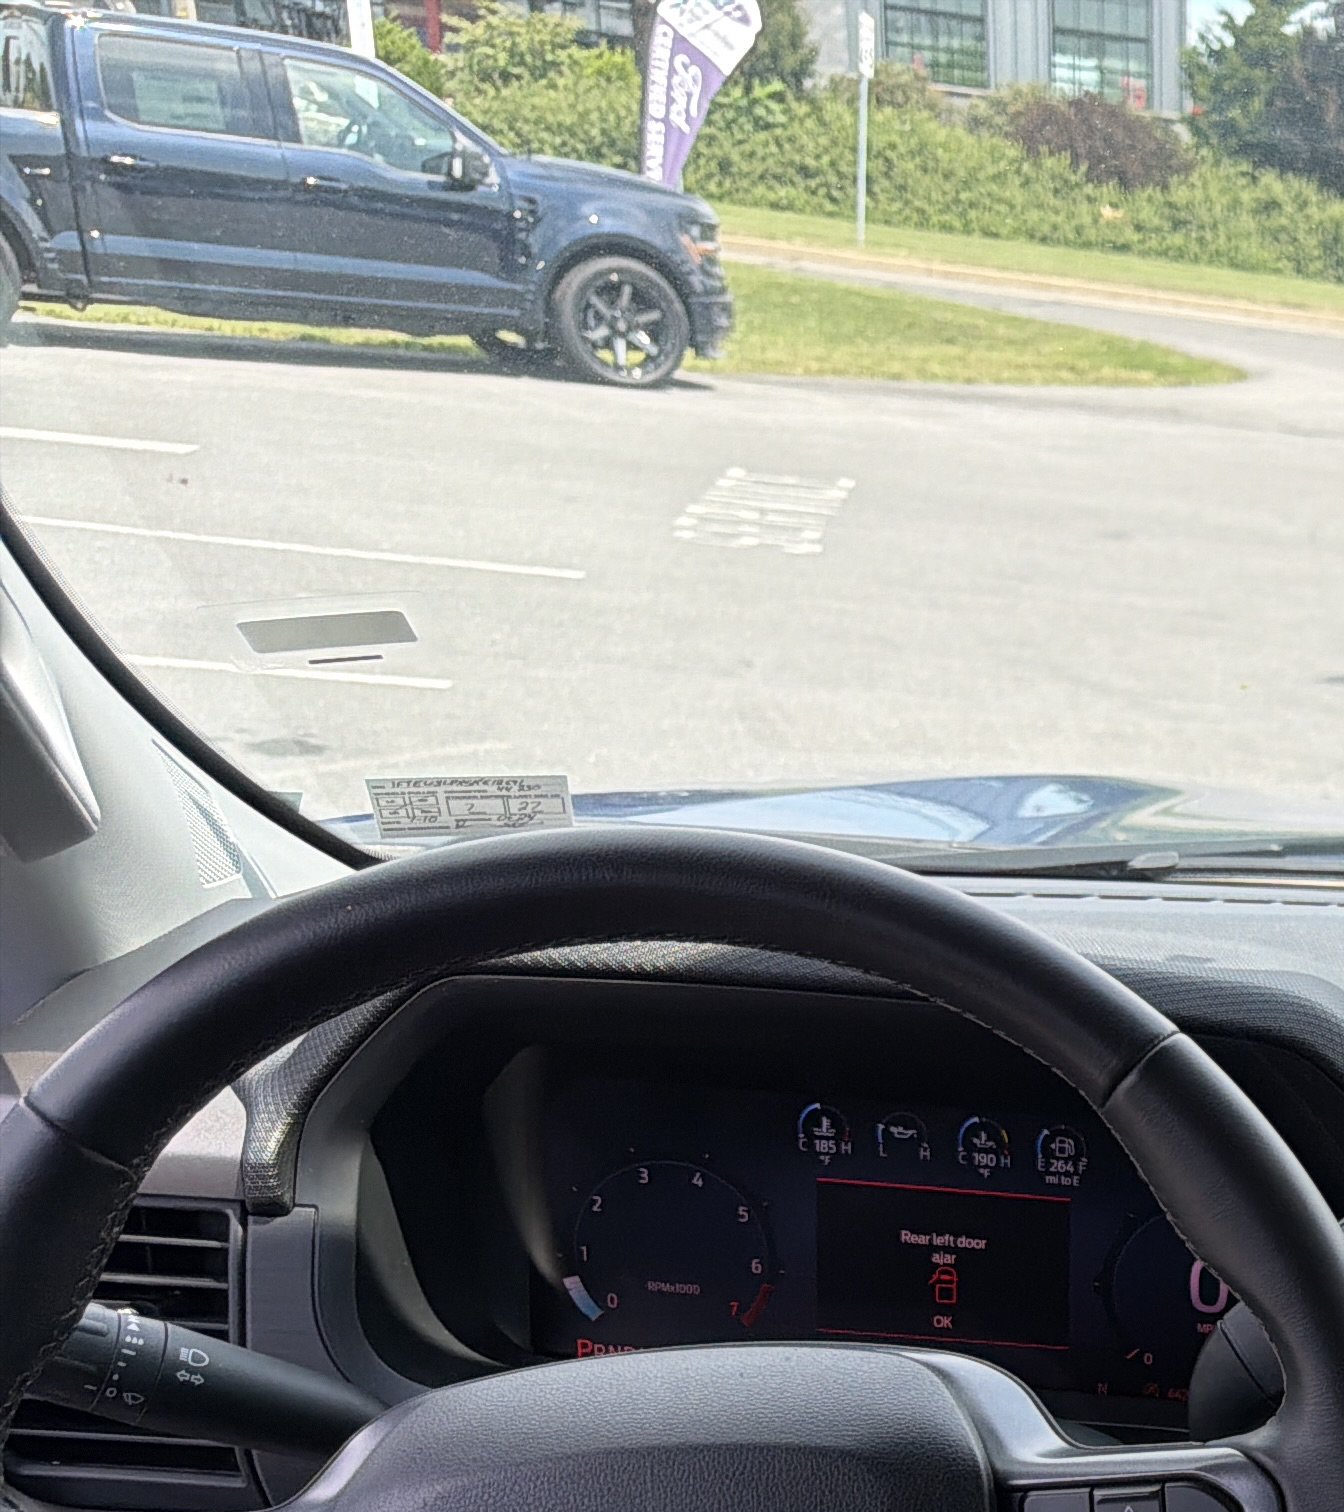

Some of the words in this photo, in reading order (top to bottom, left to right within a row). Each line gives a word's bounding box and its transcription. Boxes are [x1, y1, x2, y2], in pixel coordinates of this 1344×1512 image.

[669, 53, 703, 135] Ford
[815, 1139, 837, 1154] 185
[973, 1152, 996, 1167] 190
[1049, 1159, 1075, 1174] 264
[638, 1168, 649, 1184] 3
[691, 1172, 703, 1187] 4
[592, 1196, 602, 1212] 2
[737, 1206, 749, 1222] 5
[900, 1230, 931, 1245] Rear
[932, 1232, 955, 1247] left
[957, 1235, 988, 1249] door
[931, 1251, 957, 1265] ajar
[751, 1259, 762, 1274] 6
[607, 1293, 618, 1308] 0
[933, 1315, 953, 1329] OK
[1197, 1323, 1217, 1334] MP
[1143, 1353, 1153, 1365] 0
